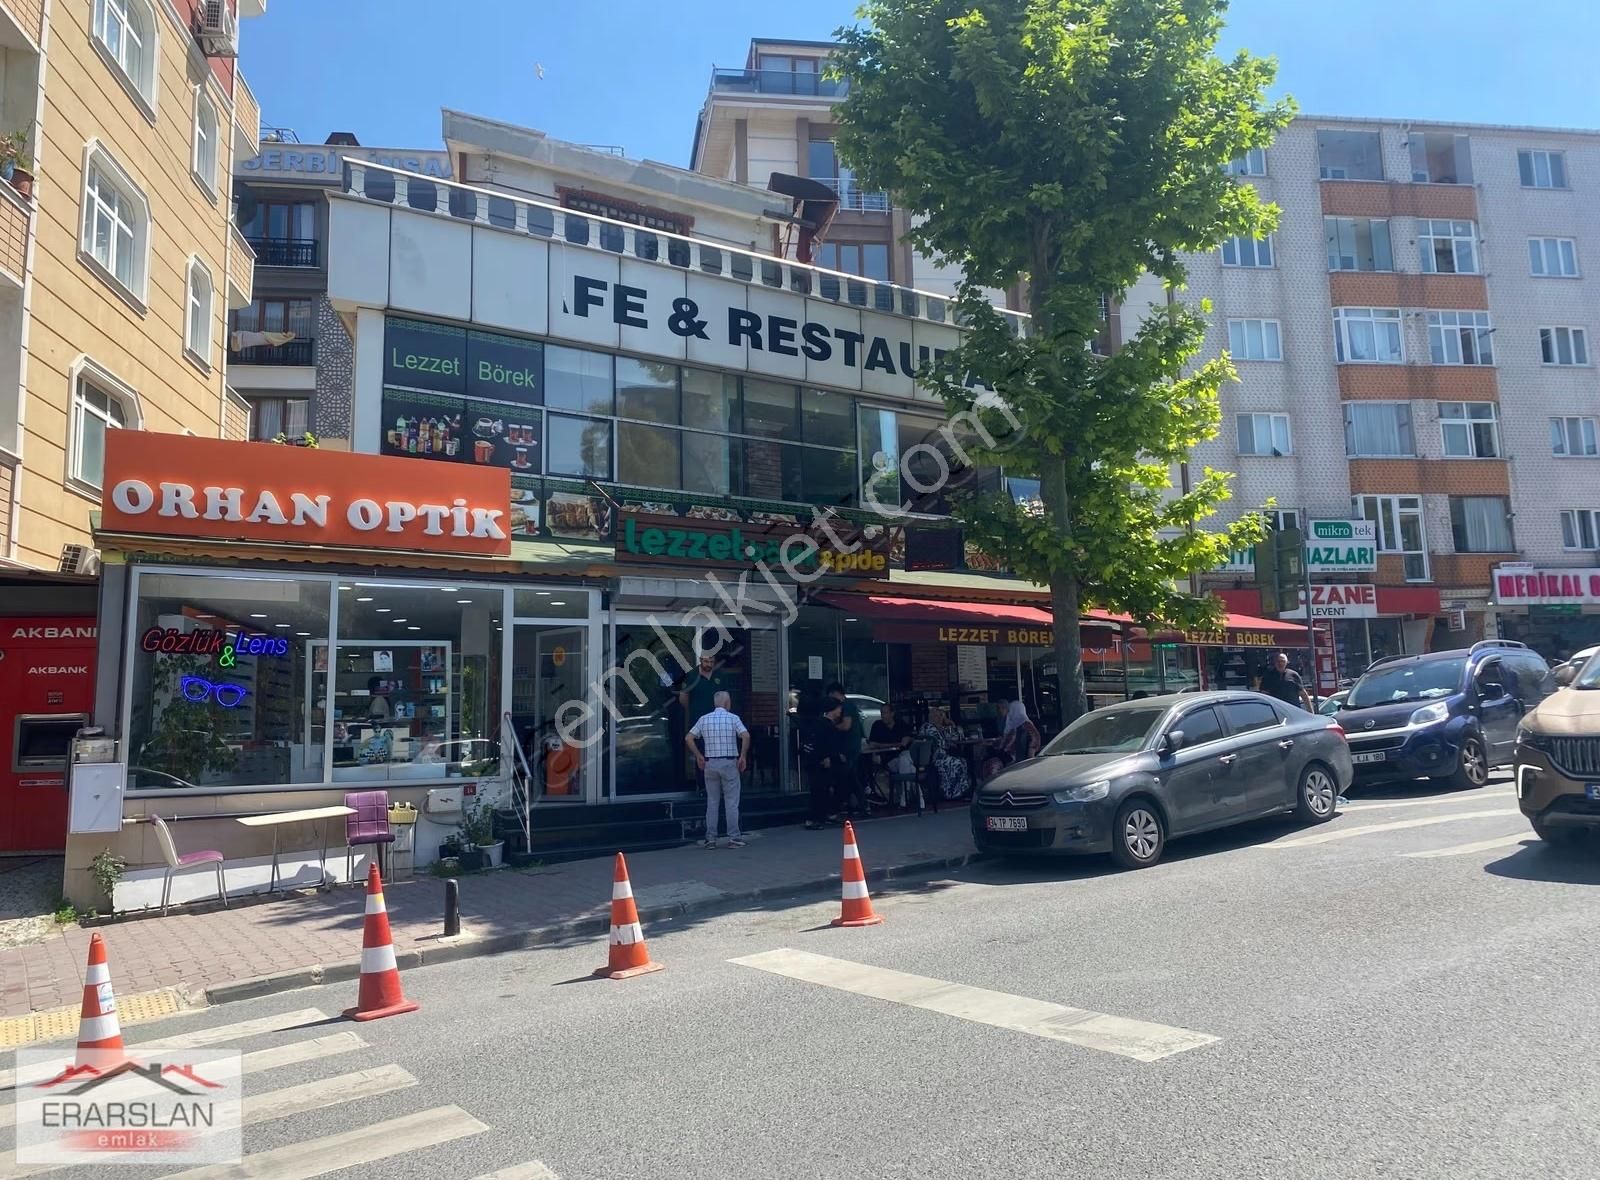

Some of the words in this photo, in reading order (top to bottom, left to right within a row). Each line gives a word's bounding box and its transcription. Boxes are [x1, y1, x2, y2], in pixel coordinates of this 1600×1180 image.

[563, 275, 648, 329] FE
[668, 297, 710, 340] &
[392, 347, 460, 376] Lezzet
[478, 360, 536, 388] Börek
[111, 478, 331, 528] ORHAN
[346, 498, 508, 540] OPTİK
[1317, 525, 1350, 536] mikro
[1354, 525, 1372, 536] tek
[1498, 571, 1585, 597] MEDİKAL
[1311, 607, 1347, 616] LEVENT
[940, 627, 999, 642] LEZZET
[1184, 631, 1231, 645] LEZZET
[143, 630, 224, 652] Gözlük
[219, 645, 235, 667] &
[235, 631, 288, 654] Lens
[28, 666, 88, 674] AKBANK
